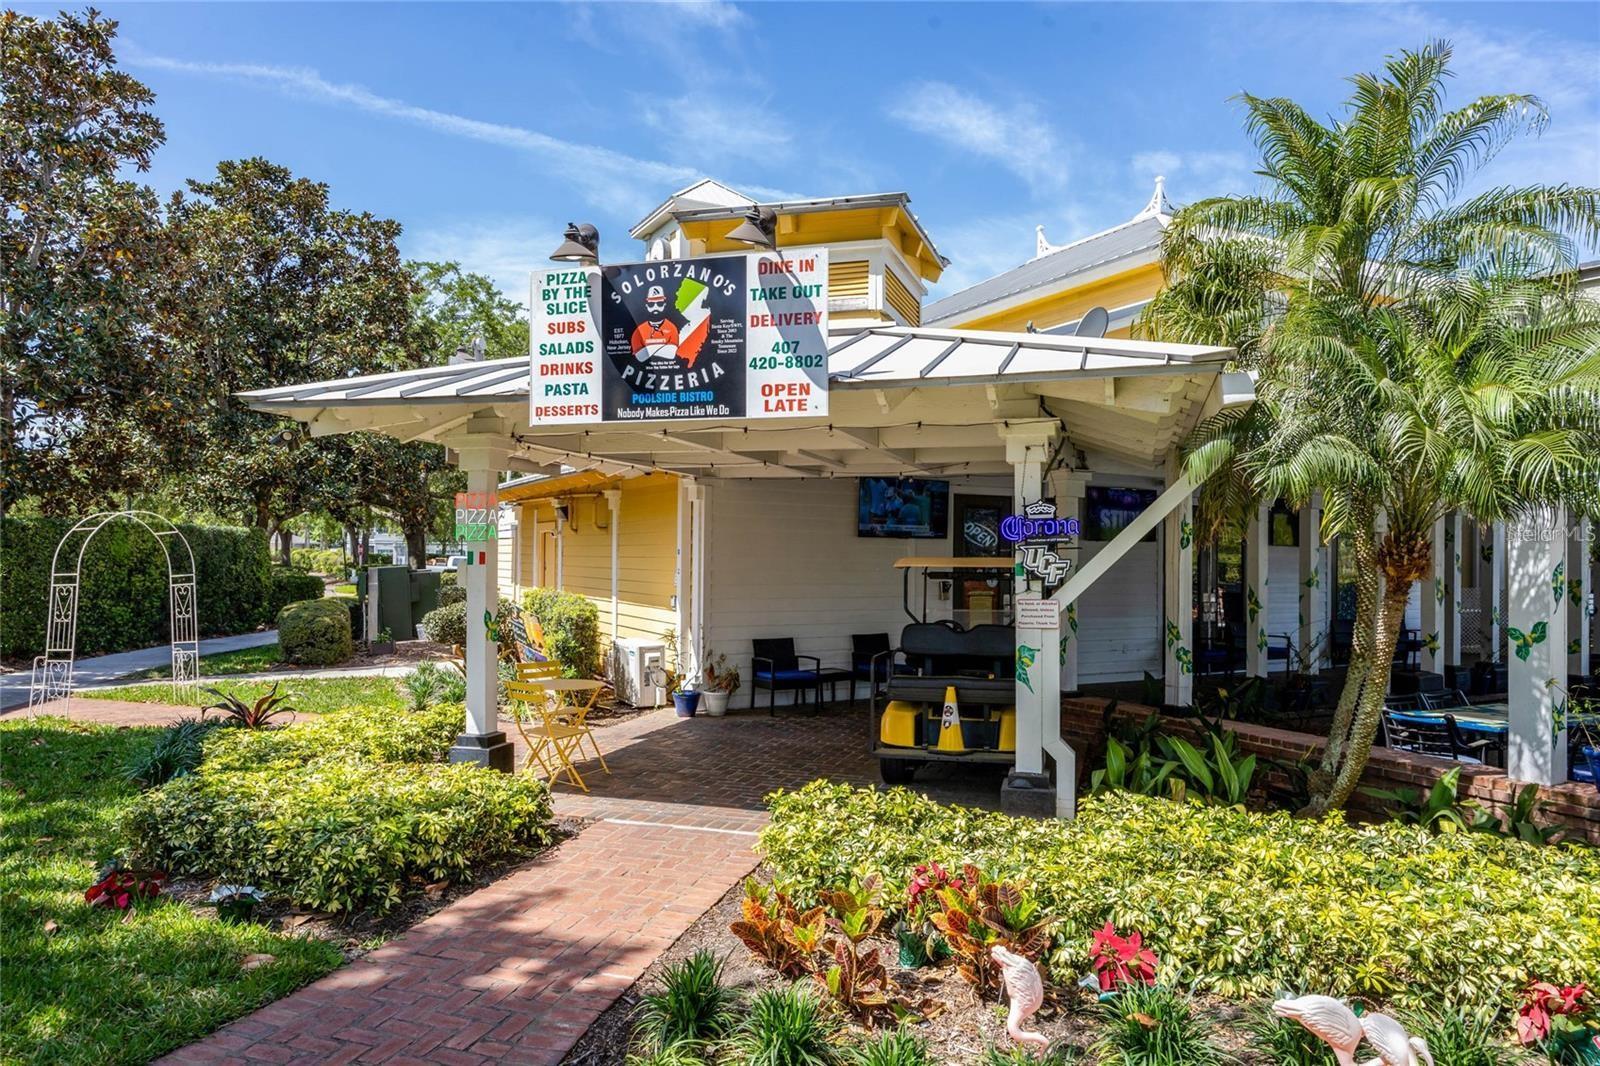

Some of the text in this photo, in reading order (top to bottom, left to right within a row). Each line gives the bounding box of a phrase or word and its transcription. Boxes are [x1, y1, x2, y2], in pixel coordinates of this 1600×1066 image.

[759, 258, 815, 275] DINE IN
[546, 271, 588, 286] PIZZA
[611, 264, 736, 304] SOLORZANO'S
[542, 285, 592, 301] BY THE
[750, 284, 823, 301] TAKE OUT
[546, 301, 587, 316] SLICE
[547, 320, 586, 335] SUBS
[750, 311, 823, 328] DELIVERY
[539, 341, 594, 356] SALADS
[772, 341, 800, 355] 407
[540, 362, 594, 376] DRINKS
[749, 355, 823, 370] 420-8802
[621, 362, 725, 391] PIZZERIA
[545, 383, 589, 396] PASTA
[632, 391, 714, 404] POOLSIDE BISTRO
[761, 383, 811, 397] OPEN
[535, 404, 599, 417] DESSERTS
[617, 408, 645, 420] Nobody
[690, 405, 706, 416] Like
[706, 404, 719, 416] We
[719, 404, 730, 415] Do
[764, 399, 808, 413] LATE
[455, 492, 497, 509] PIZZA
[455, 508, 498, 525] PIZZA
[455, 524, 498, 541] PIZZA
[963, 521, 994, 547] OPEN
[1000, 515, 1080, 542] Corona
[1016, 545, 1071, 585] UCF
